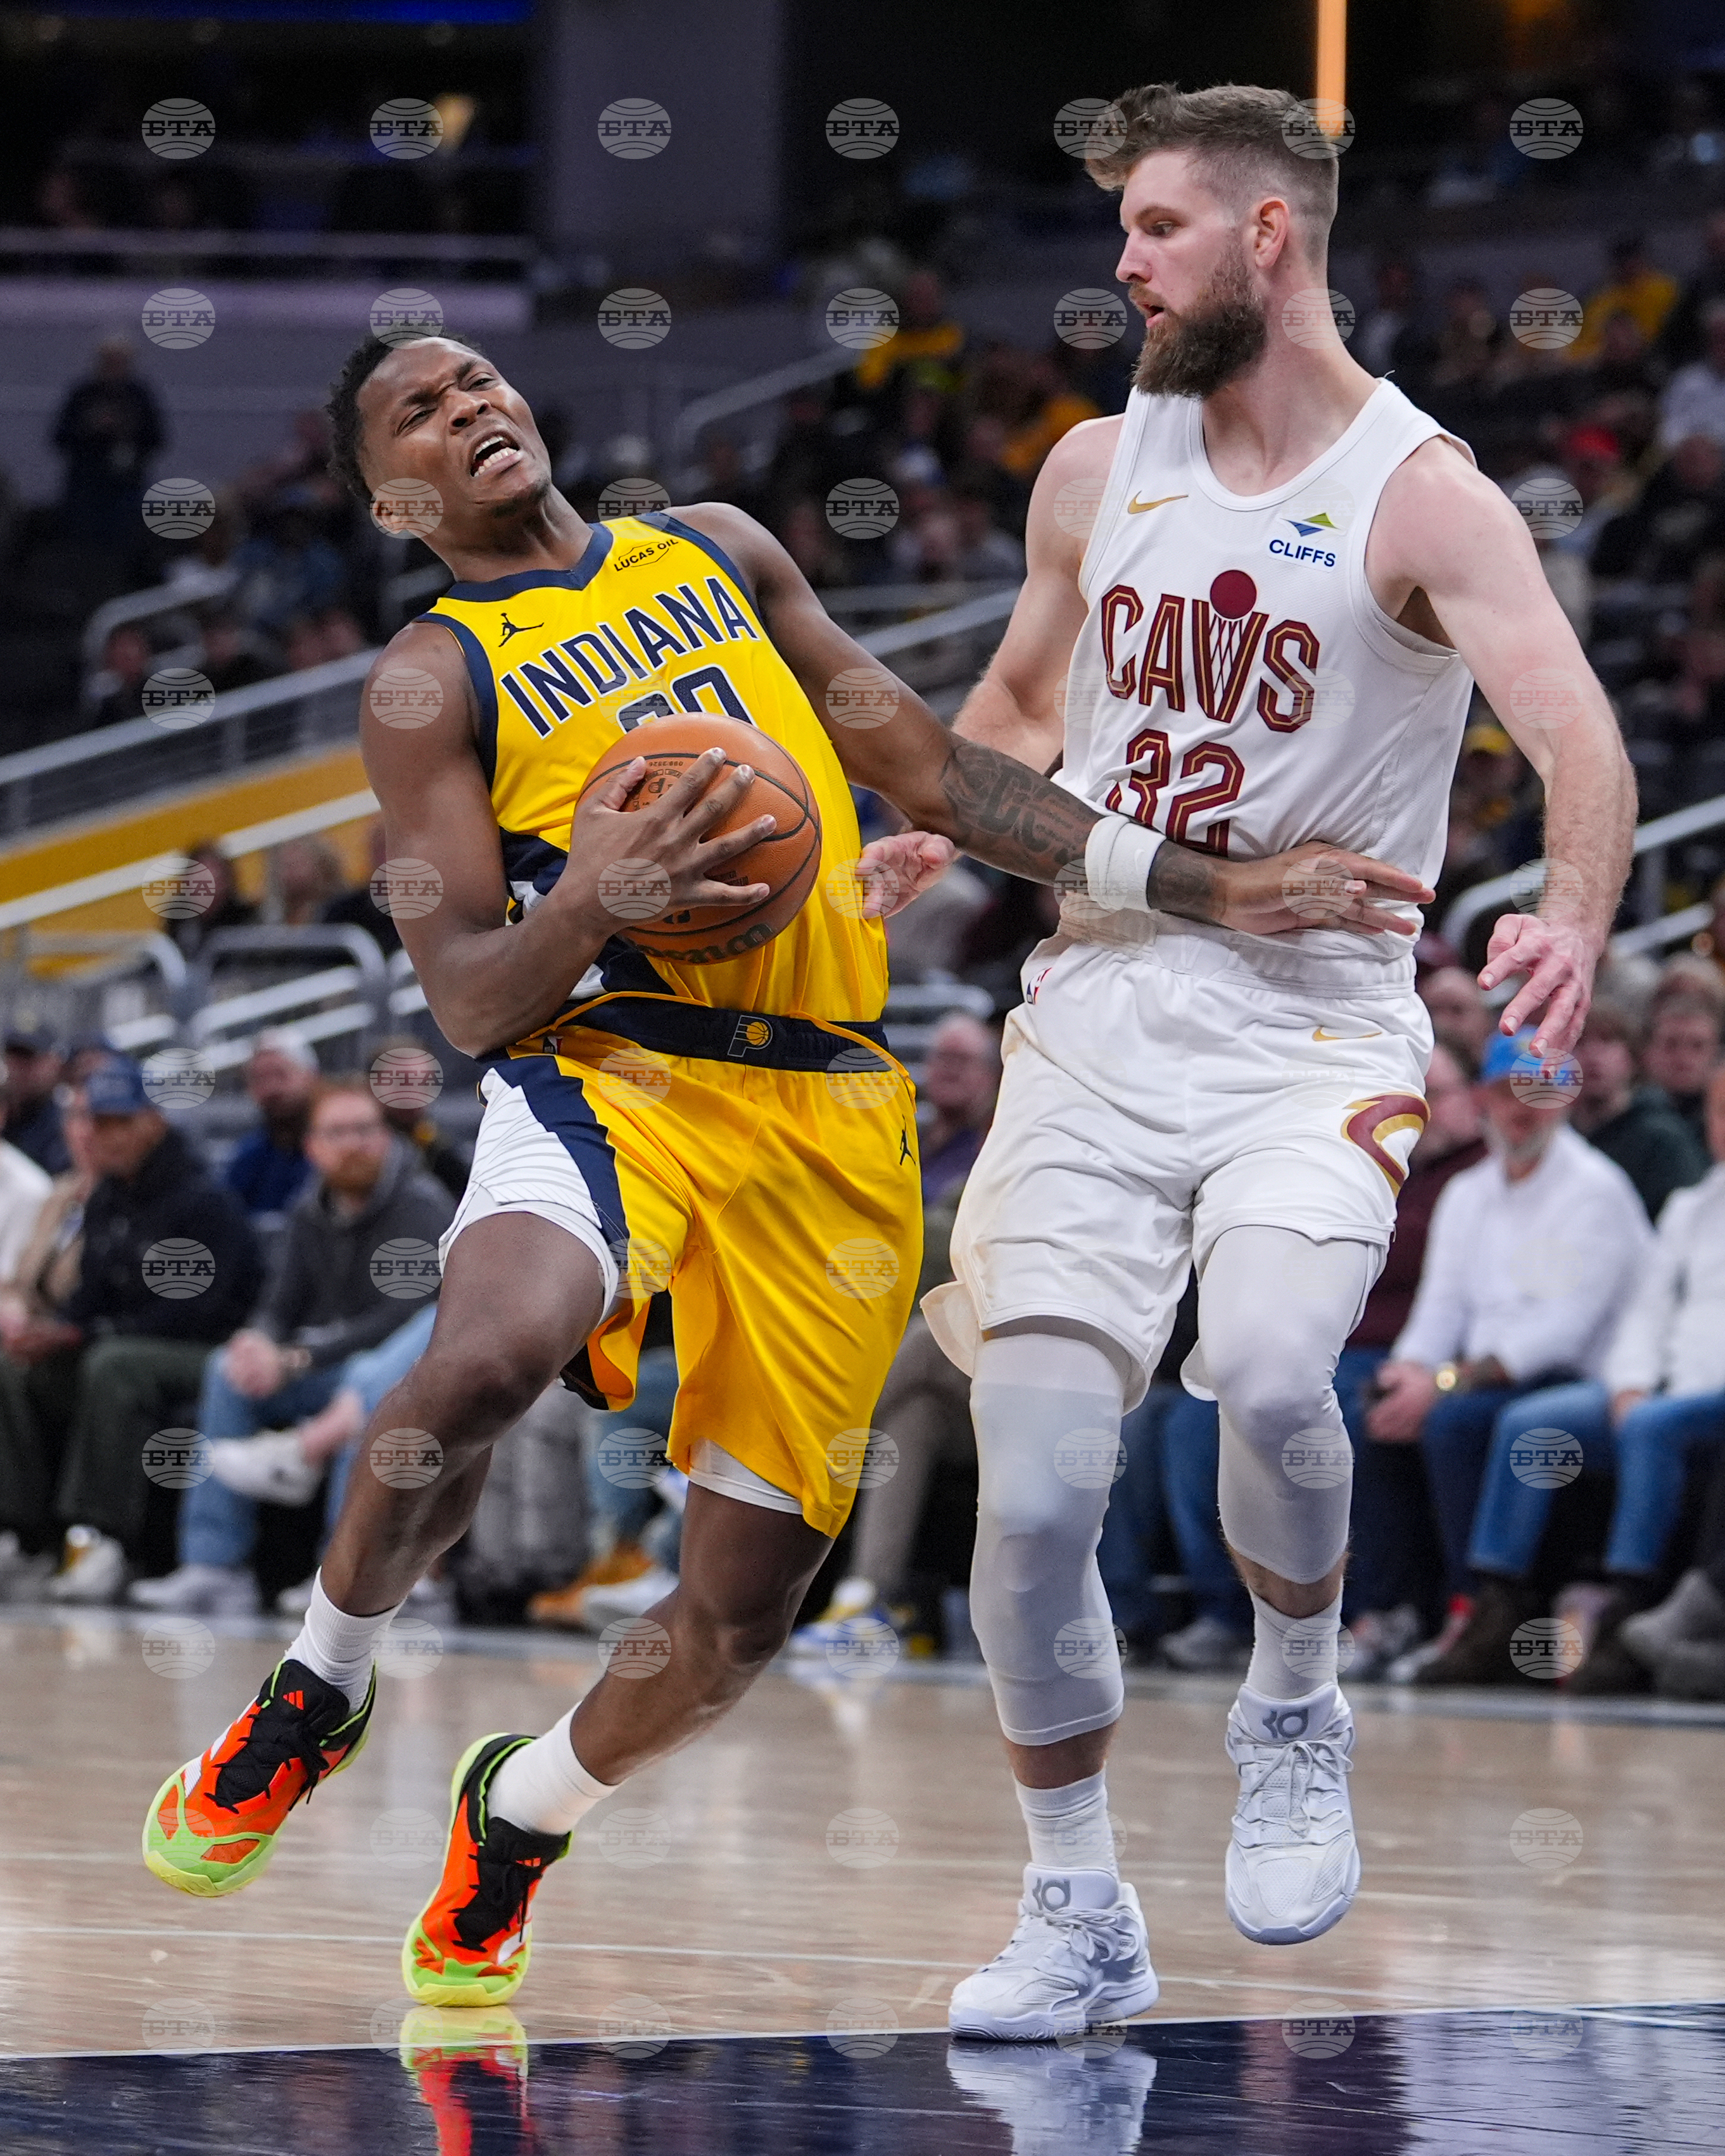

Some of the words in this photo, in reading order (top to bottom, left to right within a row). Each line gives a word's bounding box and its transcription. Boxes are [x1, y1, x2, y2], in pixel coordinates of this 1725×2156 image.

[614, 548, 654, 571] LUCAS
[657, 539, 679, 550] OIL
[1269, 539, 1336, 567] CLIFFS
[500, 576, 761, 740] INDIANA
[1101, 584, 1320, 733] CAVS
[1105, 728, 1245, 857] 32
